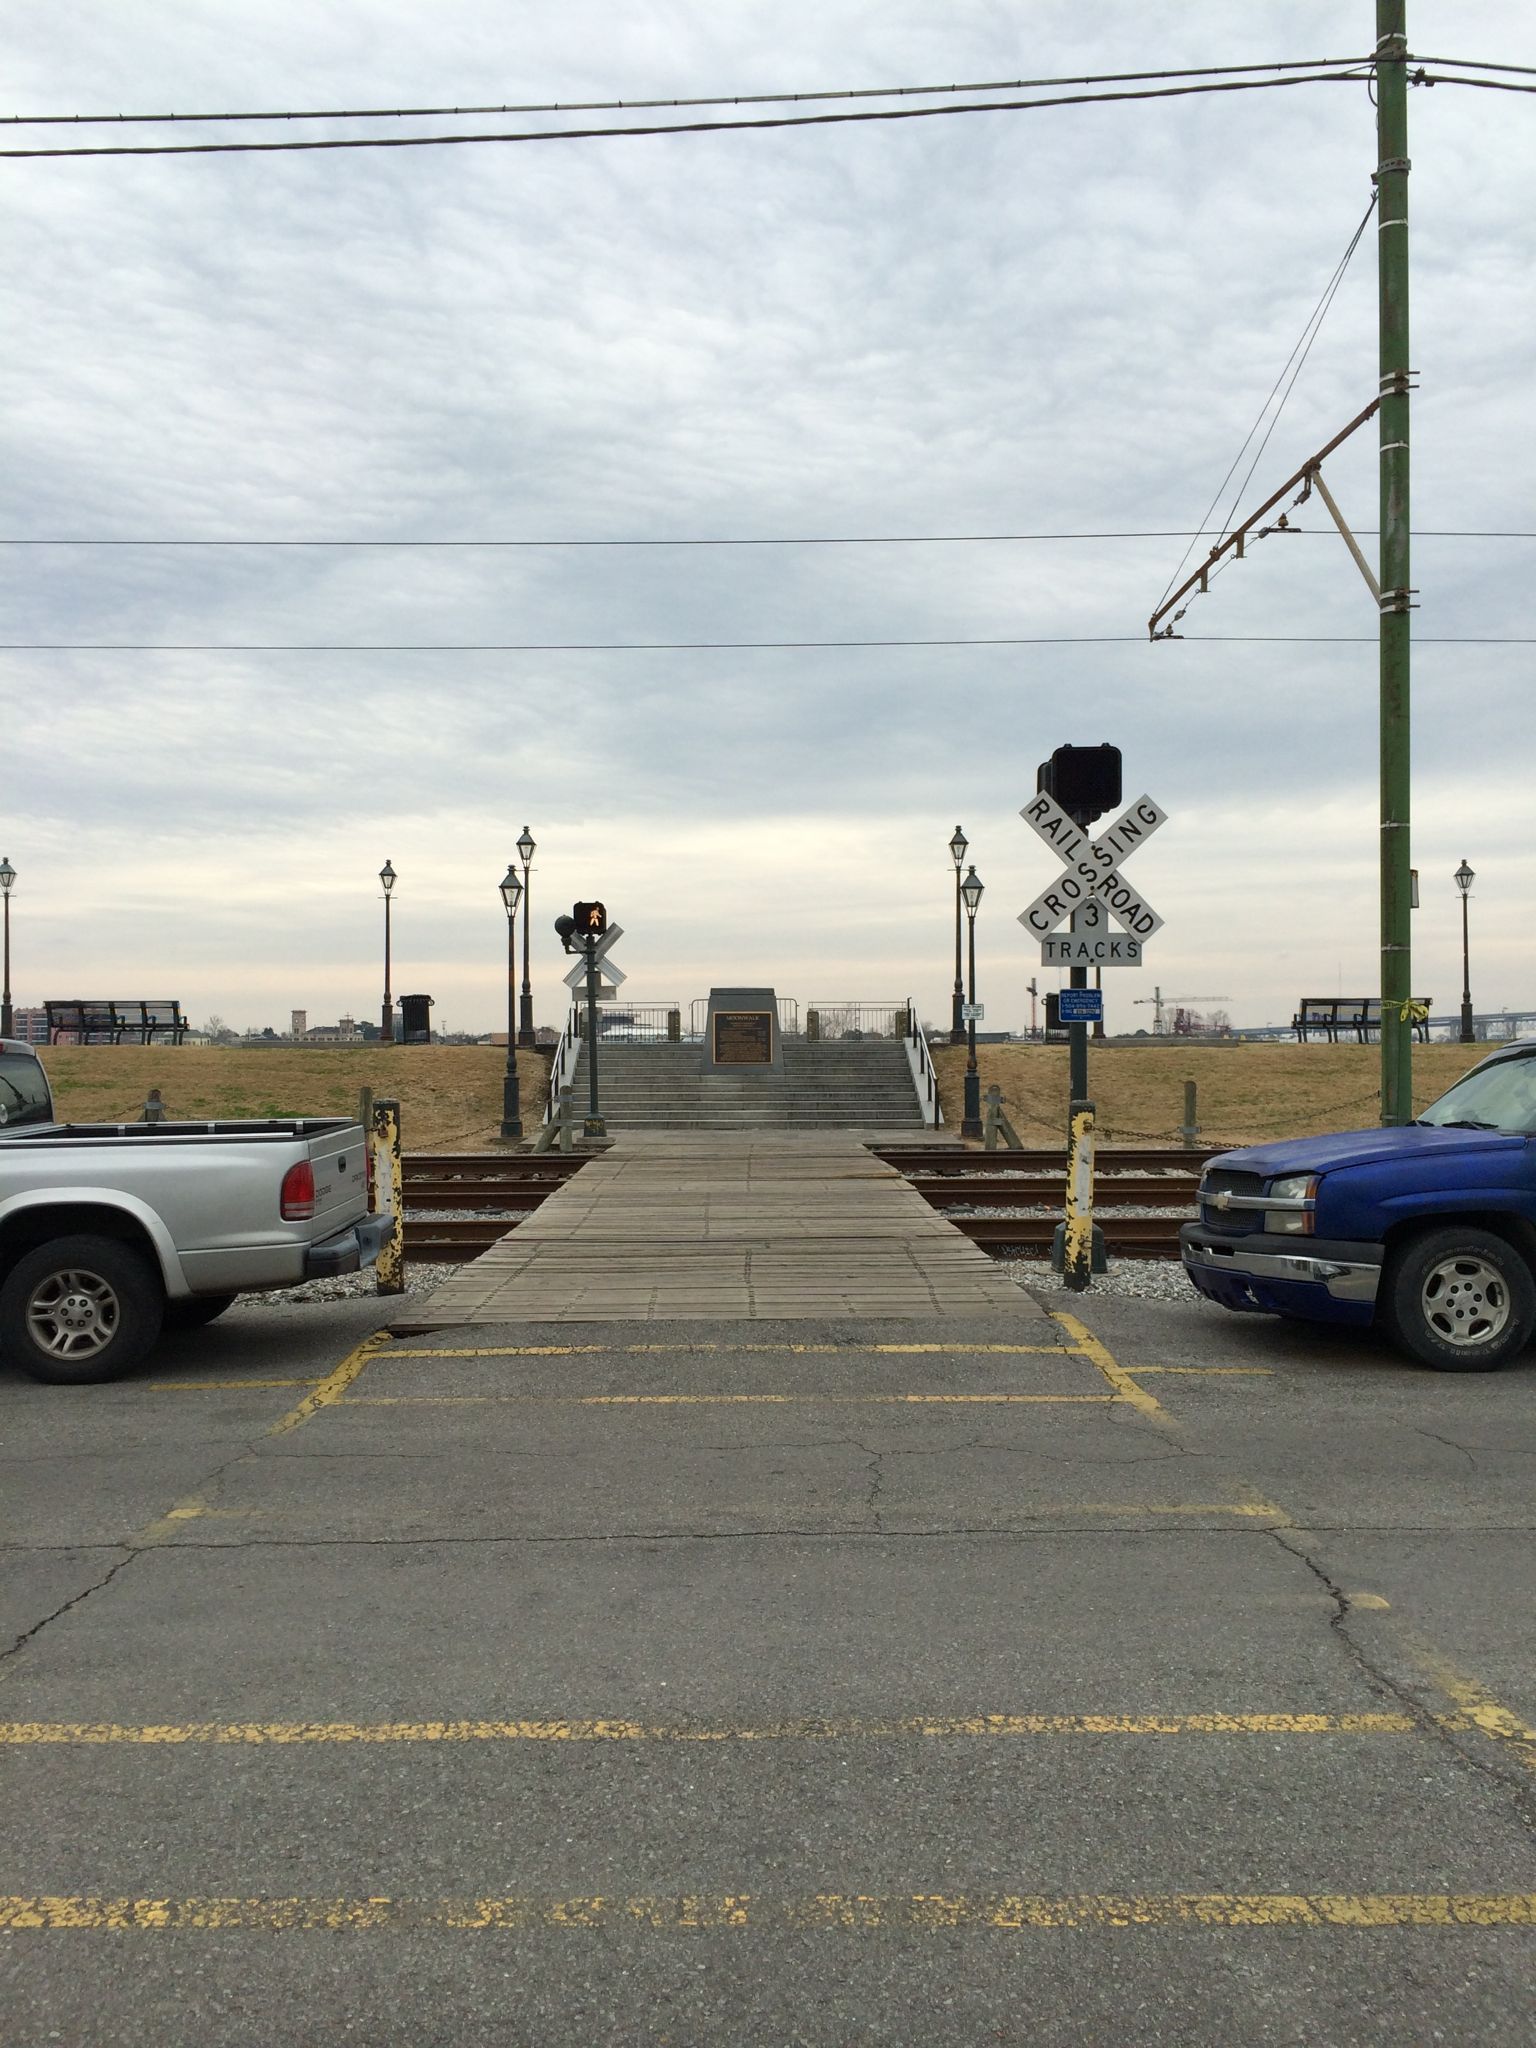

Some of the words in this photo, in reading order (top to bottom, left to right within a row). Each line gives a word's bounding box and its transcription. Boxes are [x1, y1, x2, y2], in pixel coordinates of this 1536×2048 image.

[1028, 804, 1158, 932] CROSSING
[1084, 904, 1099, 927] 3
[1046, 941, 1138, 958] TRACKS
